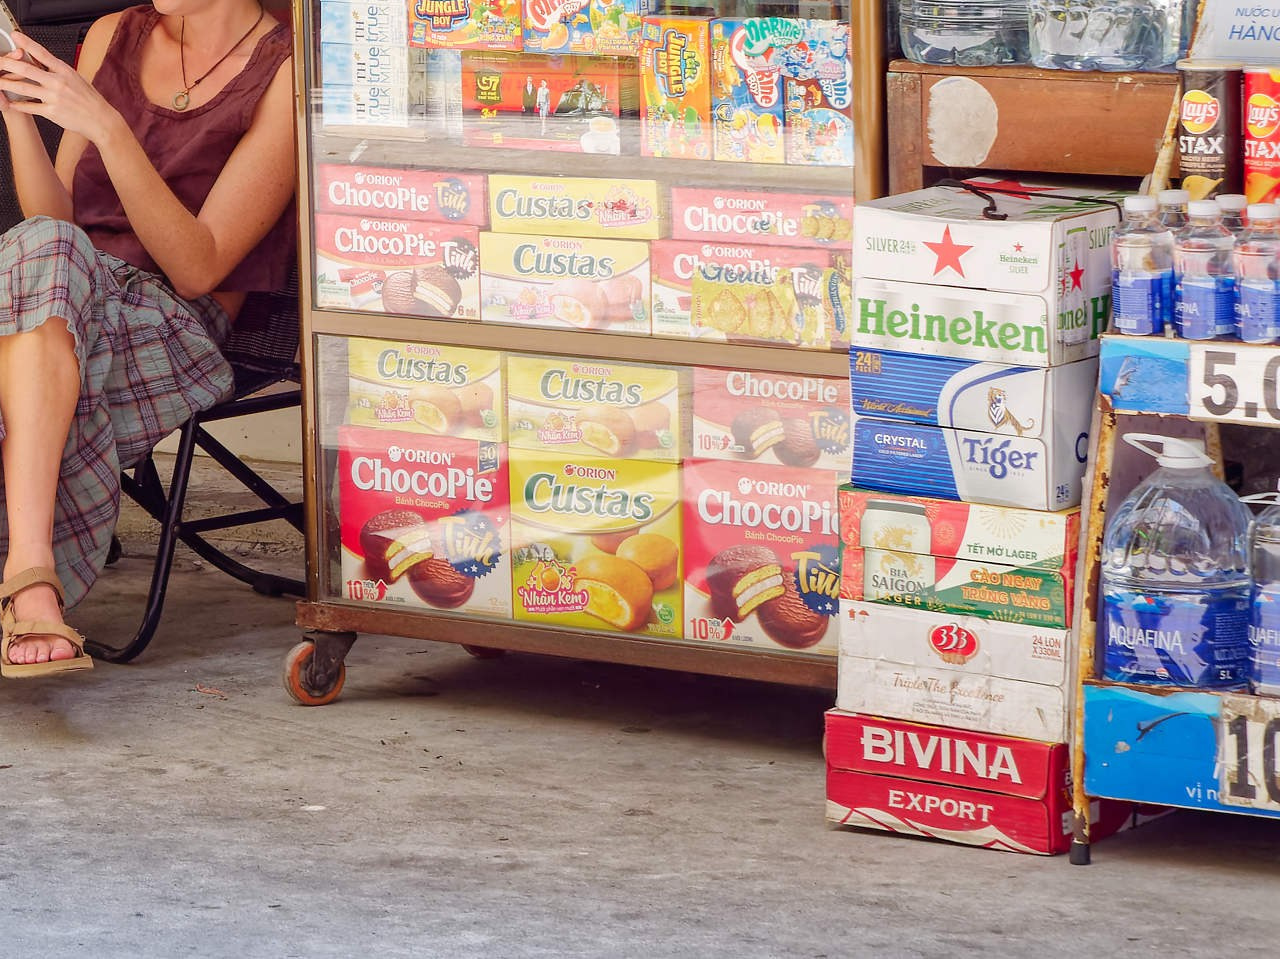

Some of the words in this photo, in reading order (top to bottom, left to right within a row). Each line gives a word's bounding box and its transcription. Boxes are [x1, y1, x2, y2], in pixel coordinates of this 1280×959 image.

[366, 6, 378, 42] true
[433, 16, 451, 28] BOY
[367, 47, 379, 83] true
[659, 52, 668, 74] BOY
[670, 32, 683, 93] JUNGLE
[1182, 101, 1217, 126] Lay's
[1248, 104, 1280, 128] Lay's
[1179, 136, 1224, 154] STAX
[1245, 140, 1280, 159] STAX
[367, 175, 400, 185] ORION
[328, 181, 430, 211] ChocoPie
[496, 189, 592, 219] Custas
[726, 199, 764, 210] ORION
[372, 223, 408, 232] ORION
[335, 228, 436, 257] ChocoPie
[552, 240, 582, 249] ORION
[866, 237, 898, 253] SILVER
[513, 244, 616, 278] Custas
[715, 247, 752, 258] ORION
[999, 255, 1038, 264] Heineken
[1009, 265, 1028, 274] SILVER
[857, 298, 1048, 354] Heineken
[378, 349, 468, 384] Custas
[856, 351, 871, 365] 24
[581, 364, 611, 376] ORION
[541, 369, 644, 406] Custas
[726, 371, 838, 403] ChocoPie
[874, 434, 927, 449] CRYSTAL
[404, 449, 452, 465] ORION
[962, 437, 1038, 479] Tiger
[351, 457, 493, 502] ChocoPie
[577, 466, 615, 480] ORION
[525, 472, 655, 521] Custas
[756, 480, 808, 497] ORION
[396, 496, 414, 506] Bánh
[415, 498, 449, 509] ChocoPie
[439, 517, 493, 566] Tình
[745, 530, 765, 540] Bánh
[766, 532, 803, 544] ChocoPie
[967, 541, 985, 555] TẾT
[1005, 547, 1037, 560] LAGER
[890, 567, 908, 578] BIA
[970, 566, 1000, 584] CÀO
[1003, 575, 1042, 590] NGAY
[872, 575, 926, 592] SAIGON
[524, 589, 556, 606] Nhân
[558, 590, 582, 605] Kem
[873, 592, 922, 606] LAGER
[962, 583, 1009, 604] TRÚNG
[1011, 590, 1050, 610] VÀNG
[690, 617, 708, 640] 10
[939, 622, 968, 650] 333
[1108, 618, 1185, 656] AQUAFINA
[1032, 635, 1043, 645] 24
[1044, 636, 1061, 648] LON
[1039, 647, 1061, 658] 330ML
[860, 725, 1022, 784] BIVINA
[888, 789, 993, 822] EXPORT
